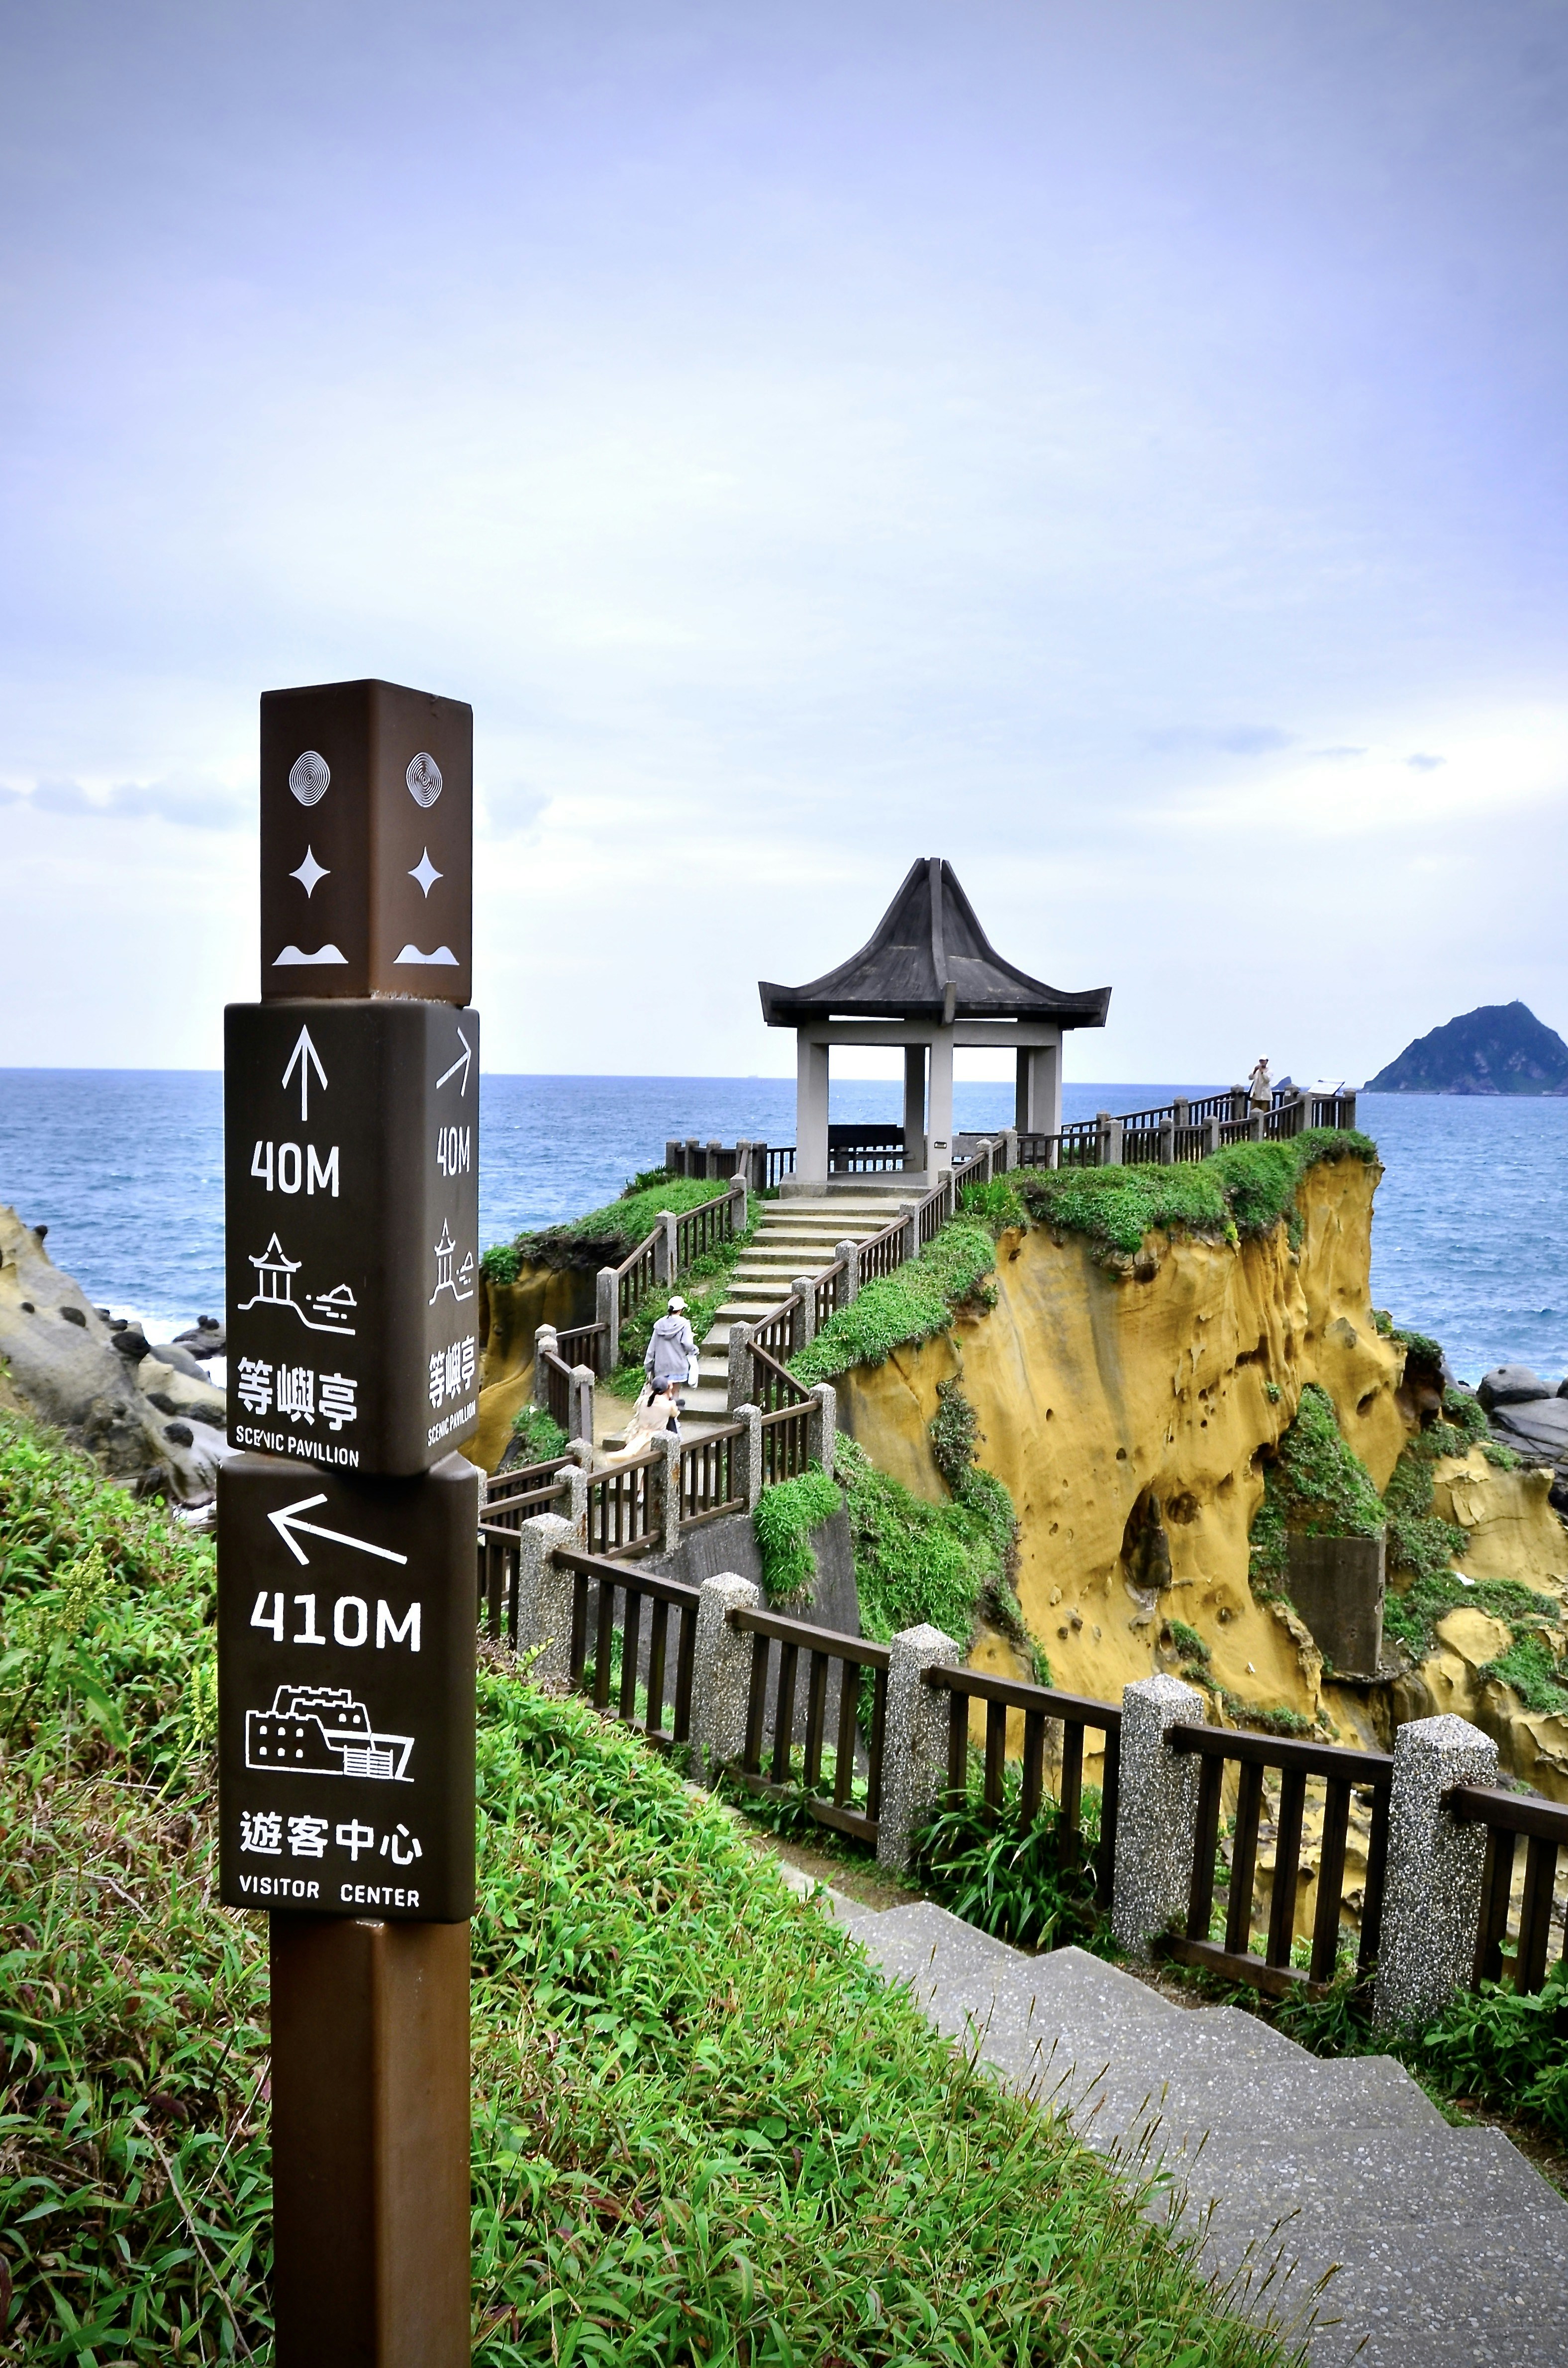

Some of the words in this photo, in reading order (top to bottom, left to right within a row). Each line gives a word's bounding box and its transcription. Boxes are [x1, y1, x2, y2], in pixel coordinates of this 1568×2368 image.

[251, 1141, 339, 1197] 40M
[437, 1126, 470, 1176] 40M
[237, 1357, 357, 1431] 等嶼亭
[429, 1335, 475, 1408] 等嶼亭
[236, 1426, 284, 1451] SCENIC
[288, 1437, 359, 1467] PAVILLION
[428, 1417, 449, 1446] SCENIC
[450, 1400, 476, 1432] PAVILLION
[250, 1592, 420, 1651] 410M
[240, 1811, 422, 1864] 遊客中心
[240, 1875, 319, 1899] VISITOR
[341, 1884, 419, 1907] CENTER
